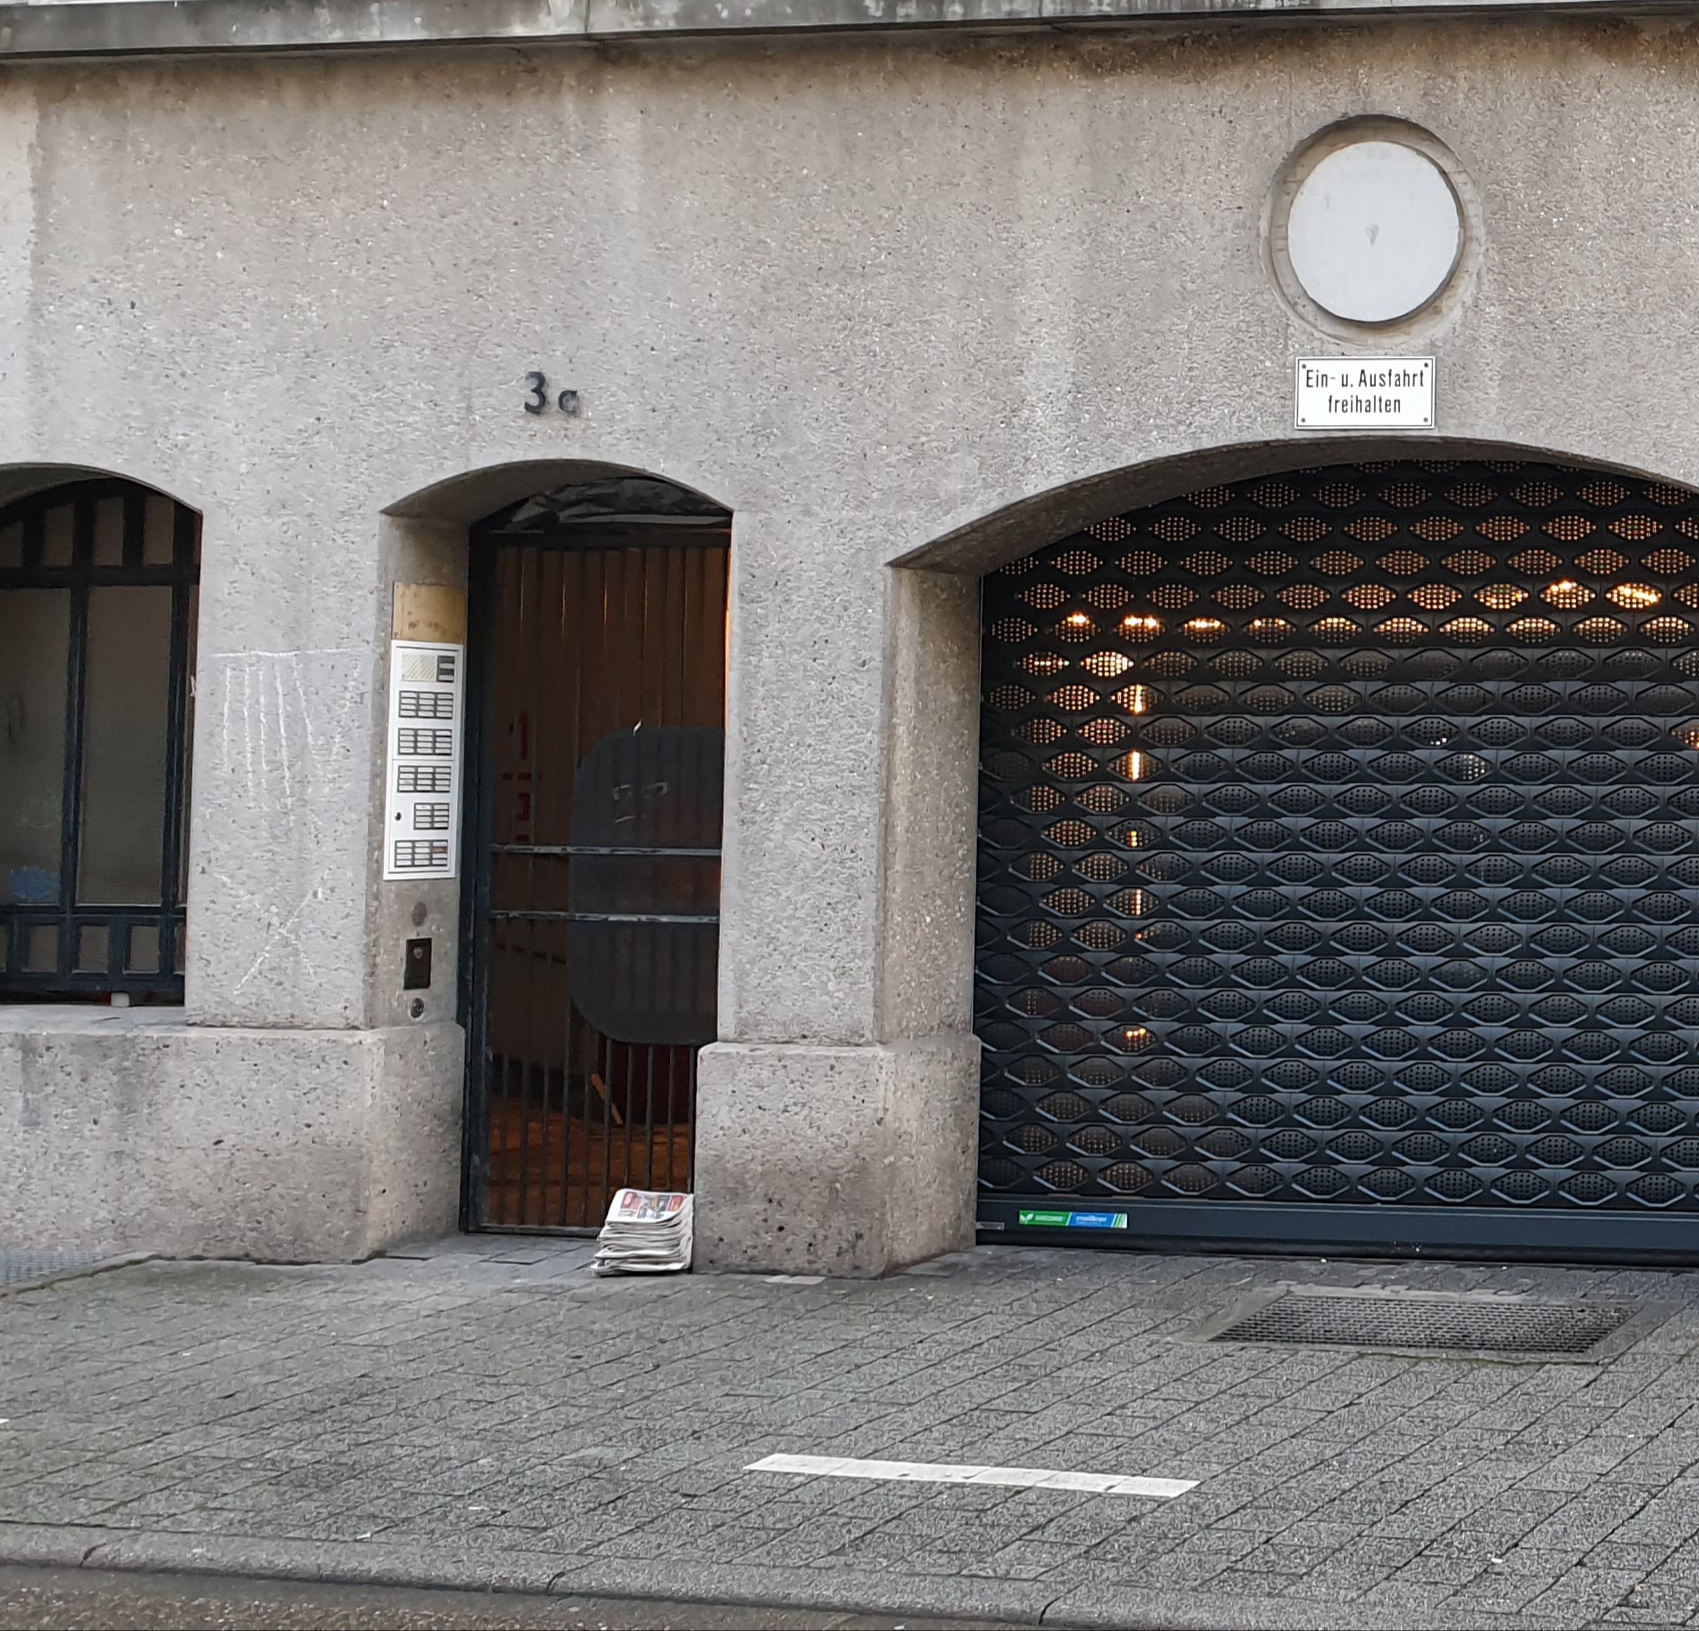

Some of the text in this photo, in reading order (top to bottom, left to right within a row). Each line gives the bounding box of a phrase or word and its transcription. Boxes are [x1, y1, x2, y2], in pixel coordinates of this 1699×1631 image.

[1306, 369, 1424, 388] Ein- u. Ausfahrt
[1328, 394, 1401, 413] freihalten
